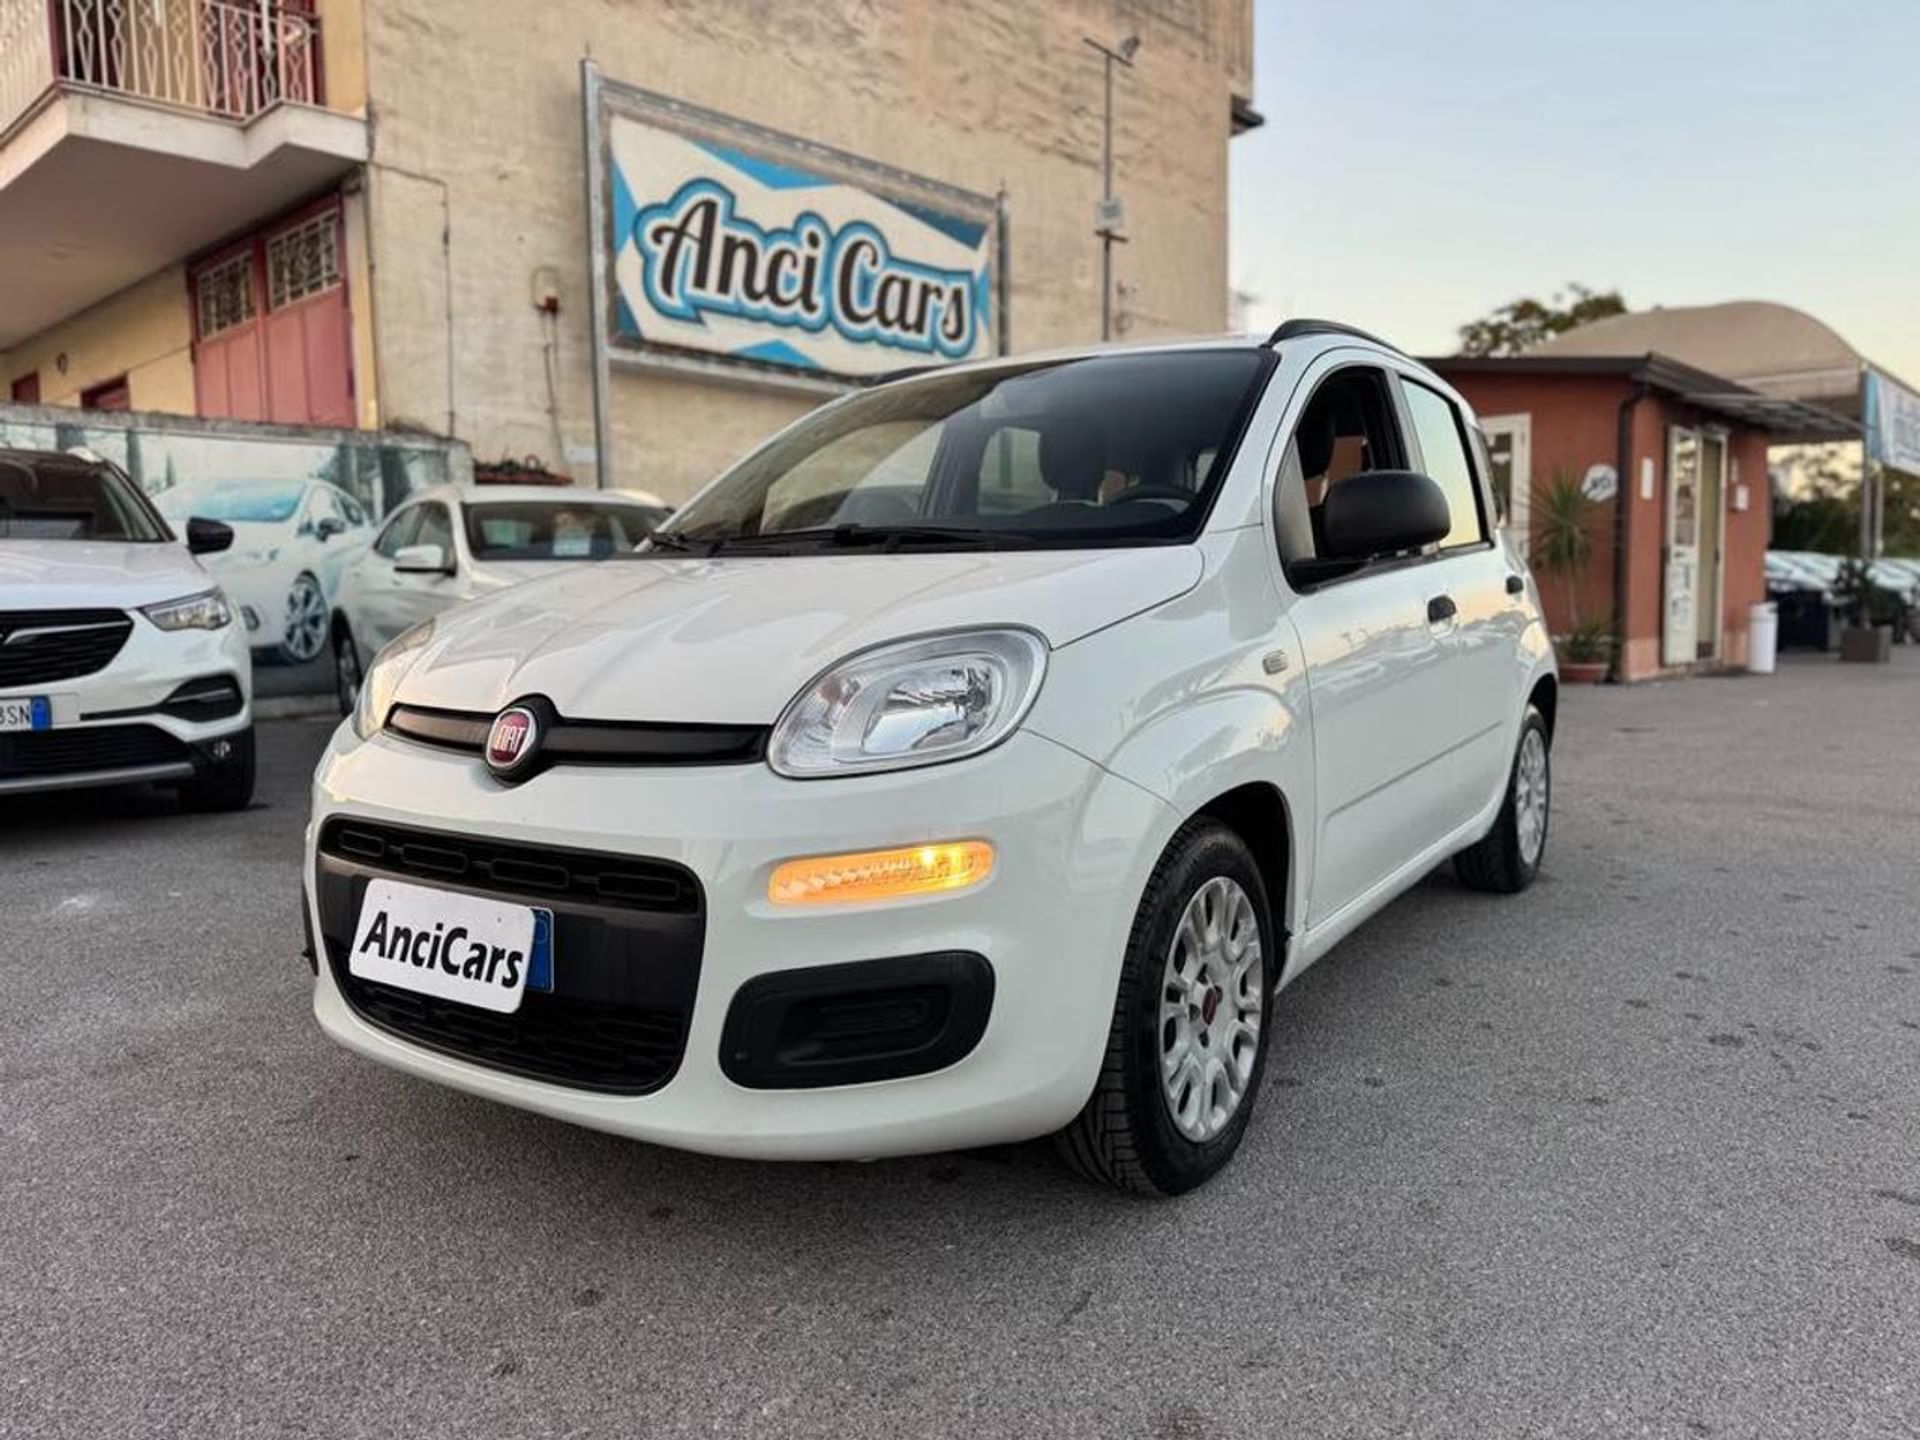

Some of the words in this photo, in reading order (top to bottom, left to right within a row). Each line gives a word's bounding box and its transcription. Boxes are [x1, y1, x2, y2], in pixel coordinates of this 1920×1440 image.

[652, 199, 818, 314] Anci
[838, 239, 965, 342] Cars
[493, 724, 526, 753] FIAT
[359, 910, 524, 989] AnciCars
